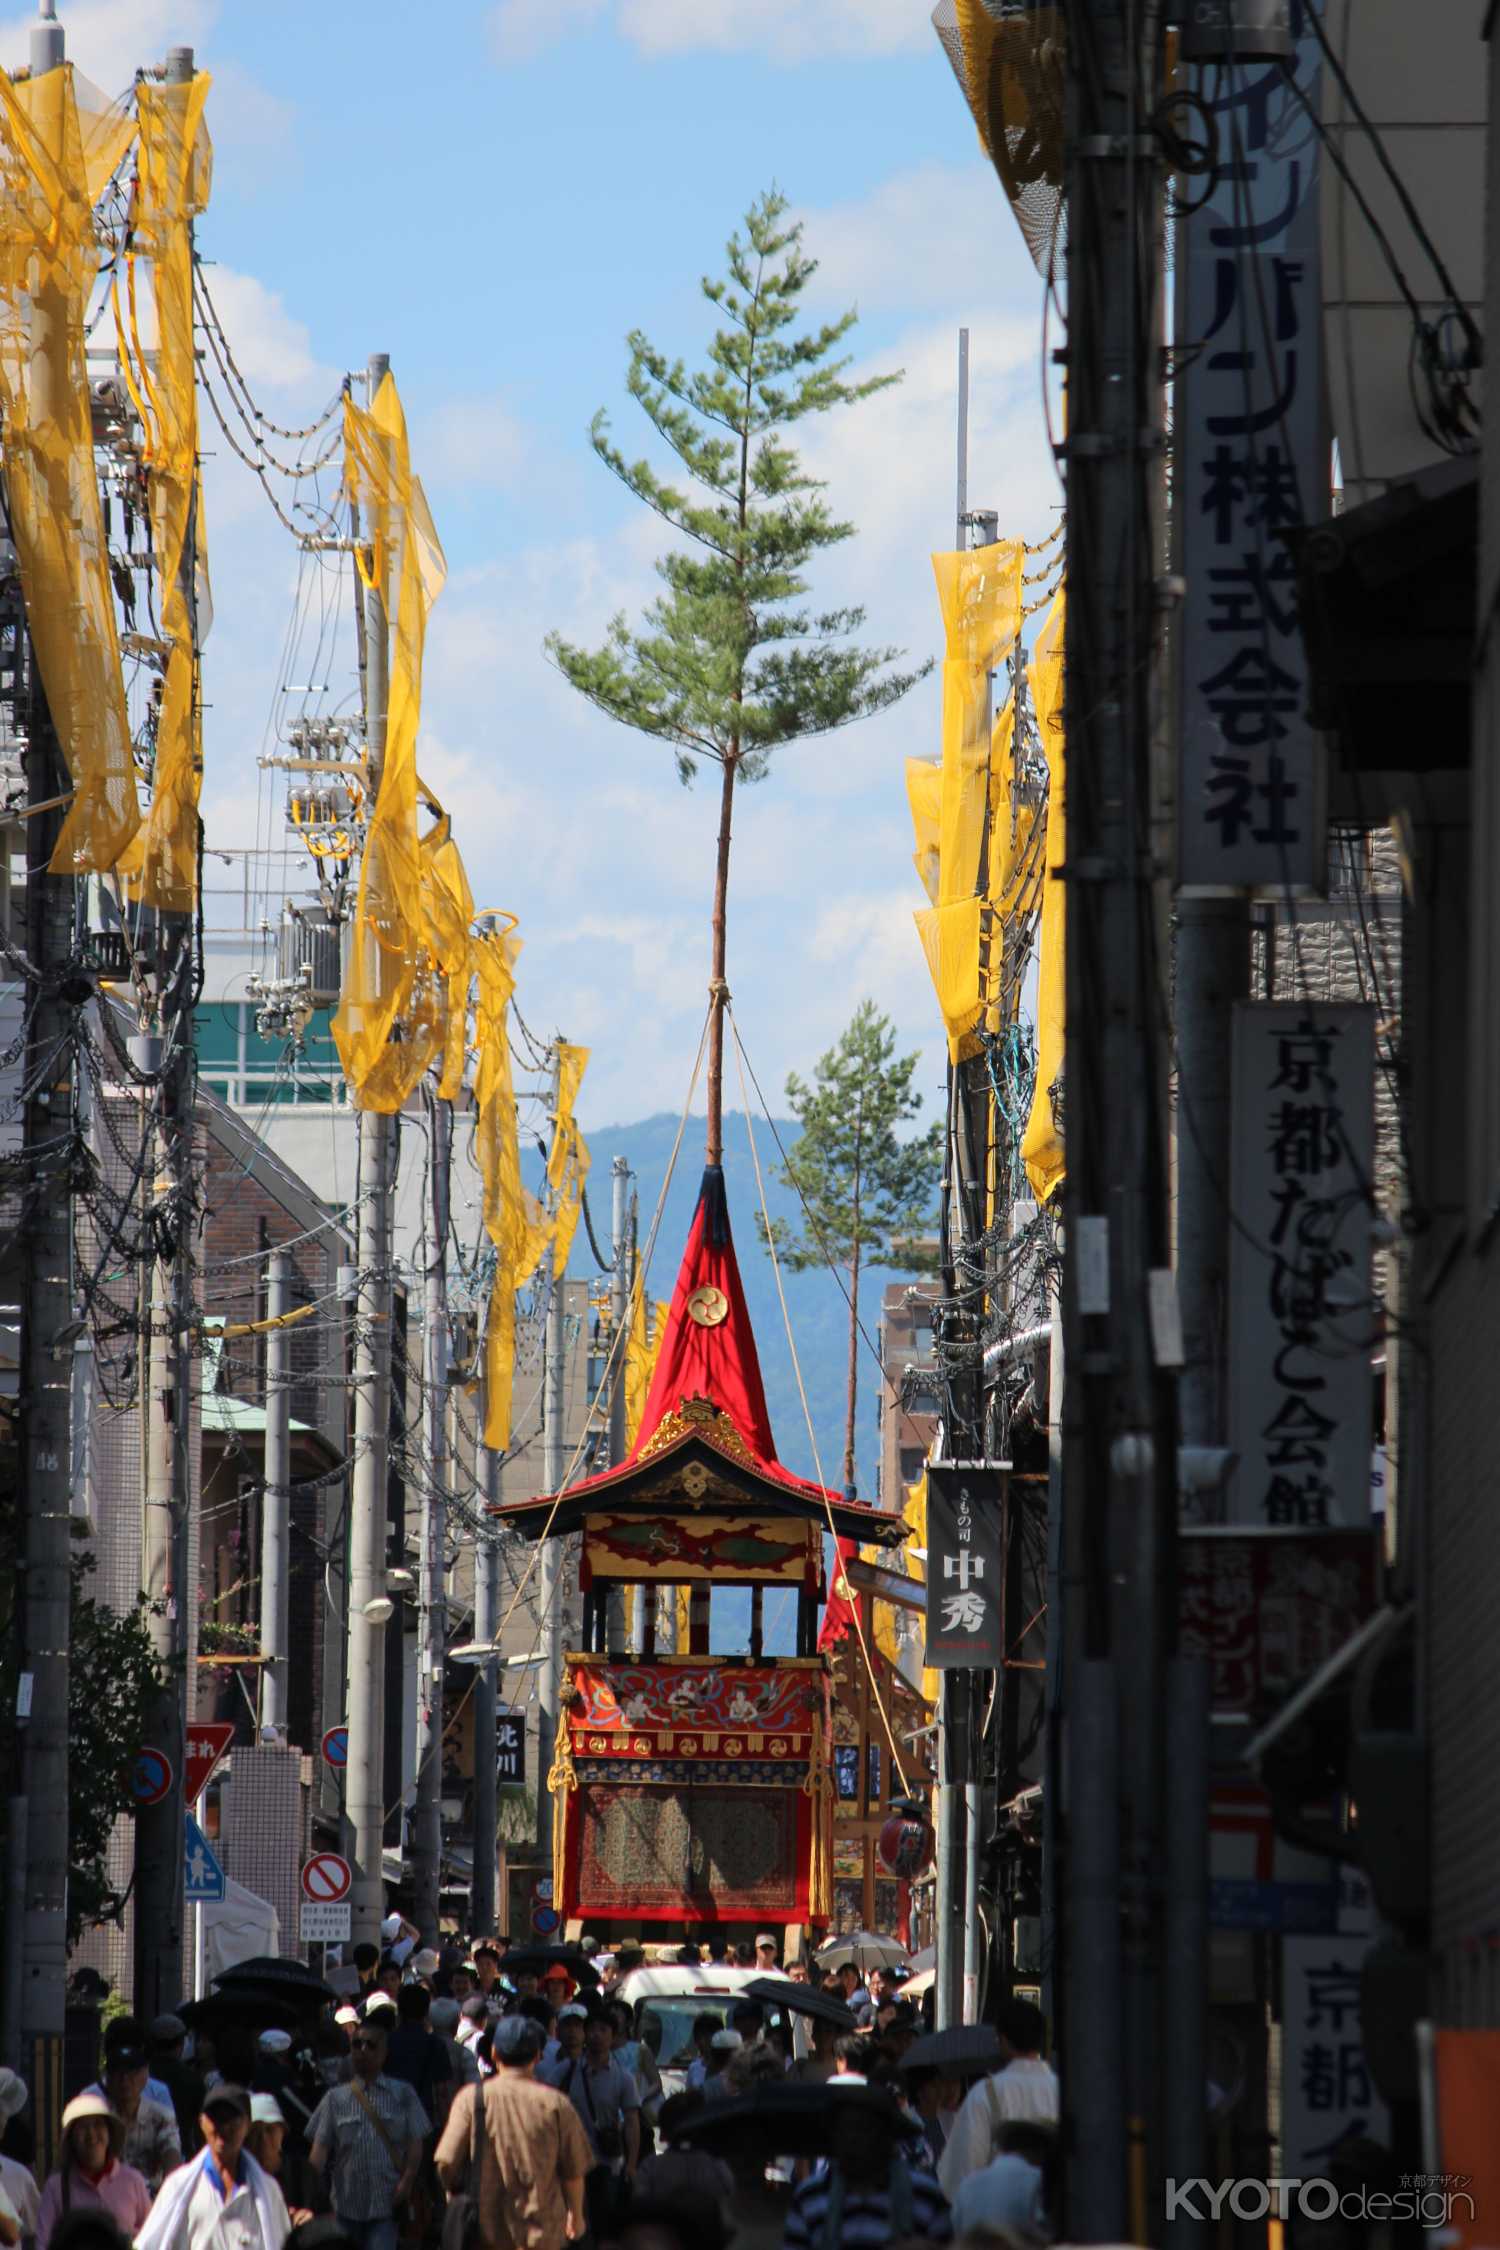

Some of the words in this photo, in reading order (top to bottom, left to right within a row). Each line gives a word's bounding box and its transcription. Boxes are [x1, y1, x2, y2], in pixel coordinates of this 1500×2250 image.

[1198, 0, 1304, 847] インバン株式会社
[1263, 1021, 1352, 1527] 京都たばこ会館
[941, 1549, 987, 1633] 中秀
[184, 1739, 216, 1758] まれ
